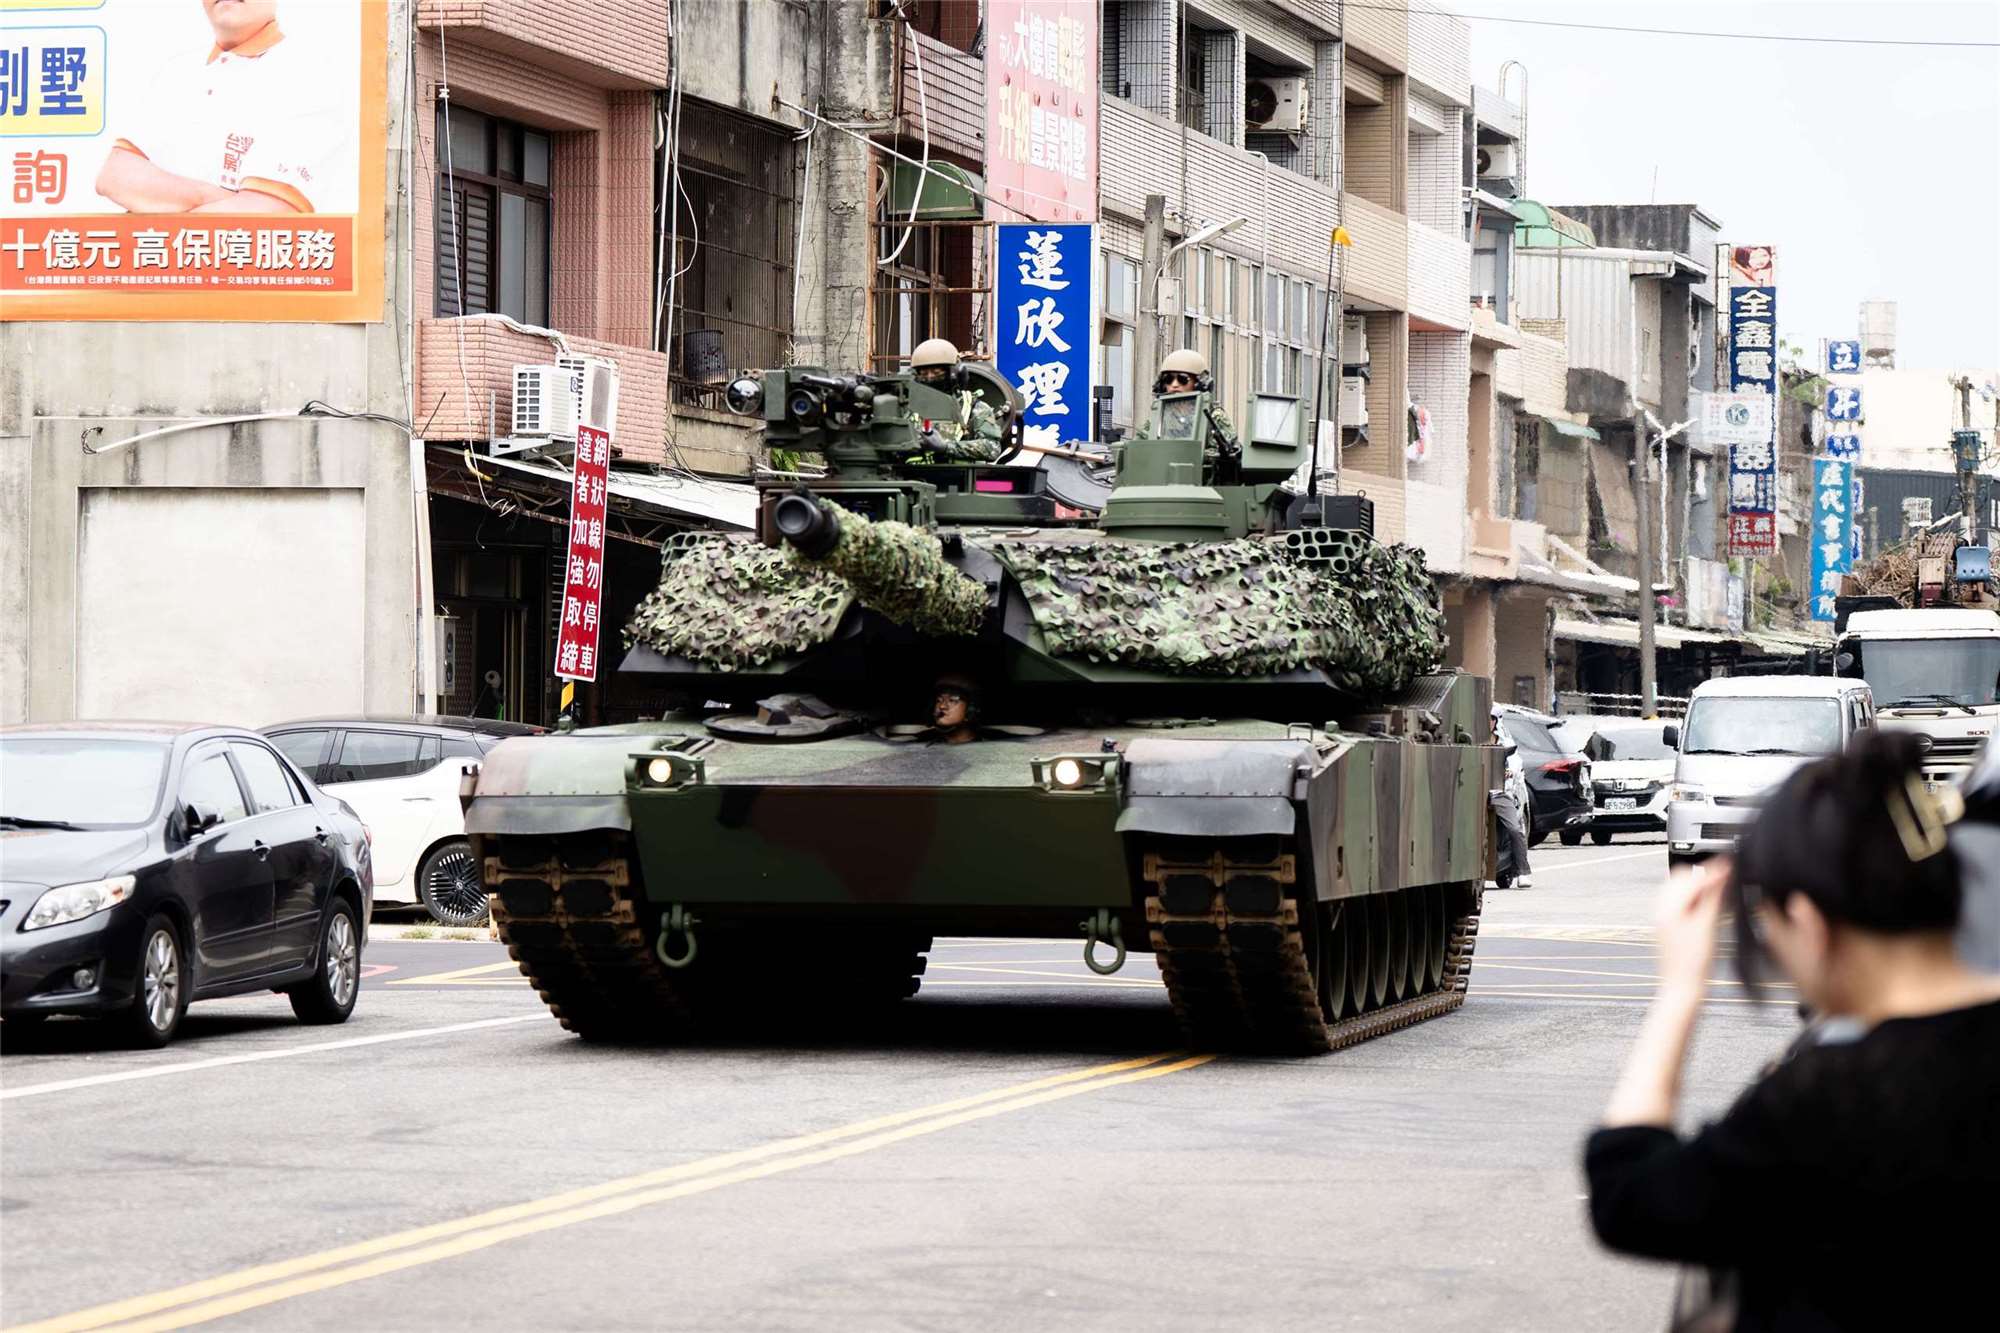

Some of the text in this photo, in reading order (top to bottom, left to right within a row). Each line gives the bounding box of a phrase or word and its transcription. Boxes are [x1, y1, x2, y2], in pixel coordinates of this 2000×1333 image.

[0, 46, 87, 116] 別墅
[13, 149, 68, 205] 詢
[2, 229, 336, 272] 十億元 高保障服務
[560, 431, 593, 673] 違者加強取締
[579, 434, 608, 675] 網狀線勿停車
